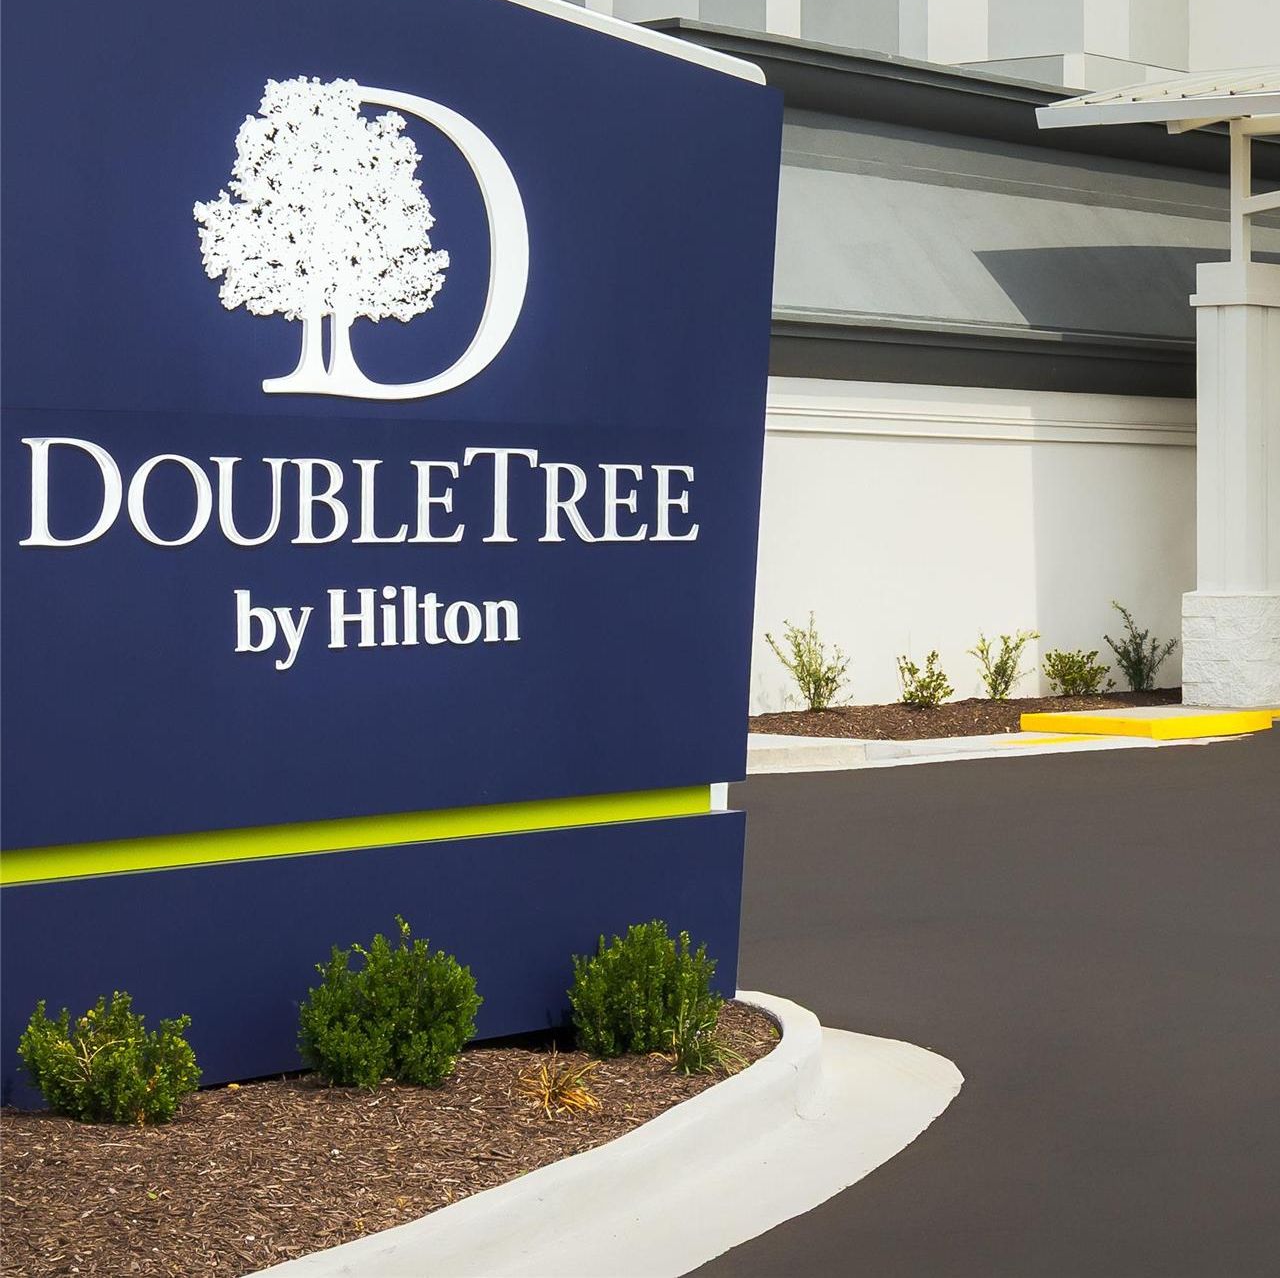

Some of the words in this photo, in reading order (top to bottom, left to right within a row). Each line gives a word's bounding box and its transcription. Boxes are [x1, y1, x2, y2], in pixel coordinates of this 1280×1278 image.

[18, 436, 700, 547] DOUBLETREE
[233, 589, 312, 670] by
[327, 585, 521, 649] Hilton
